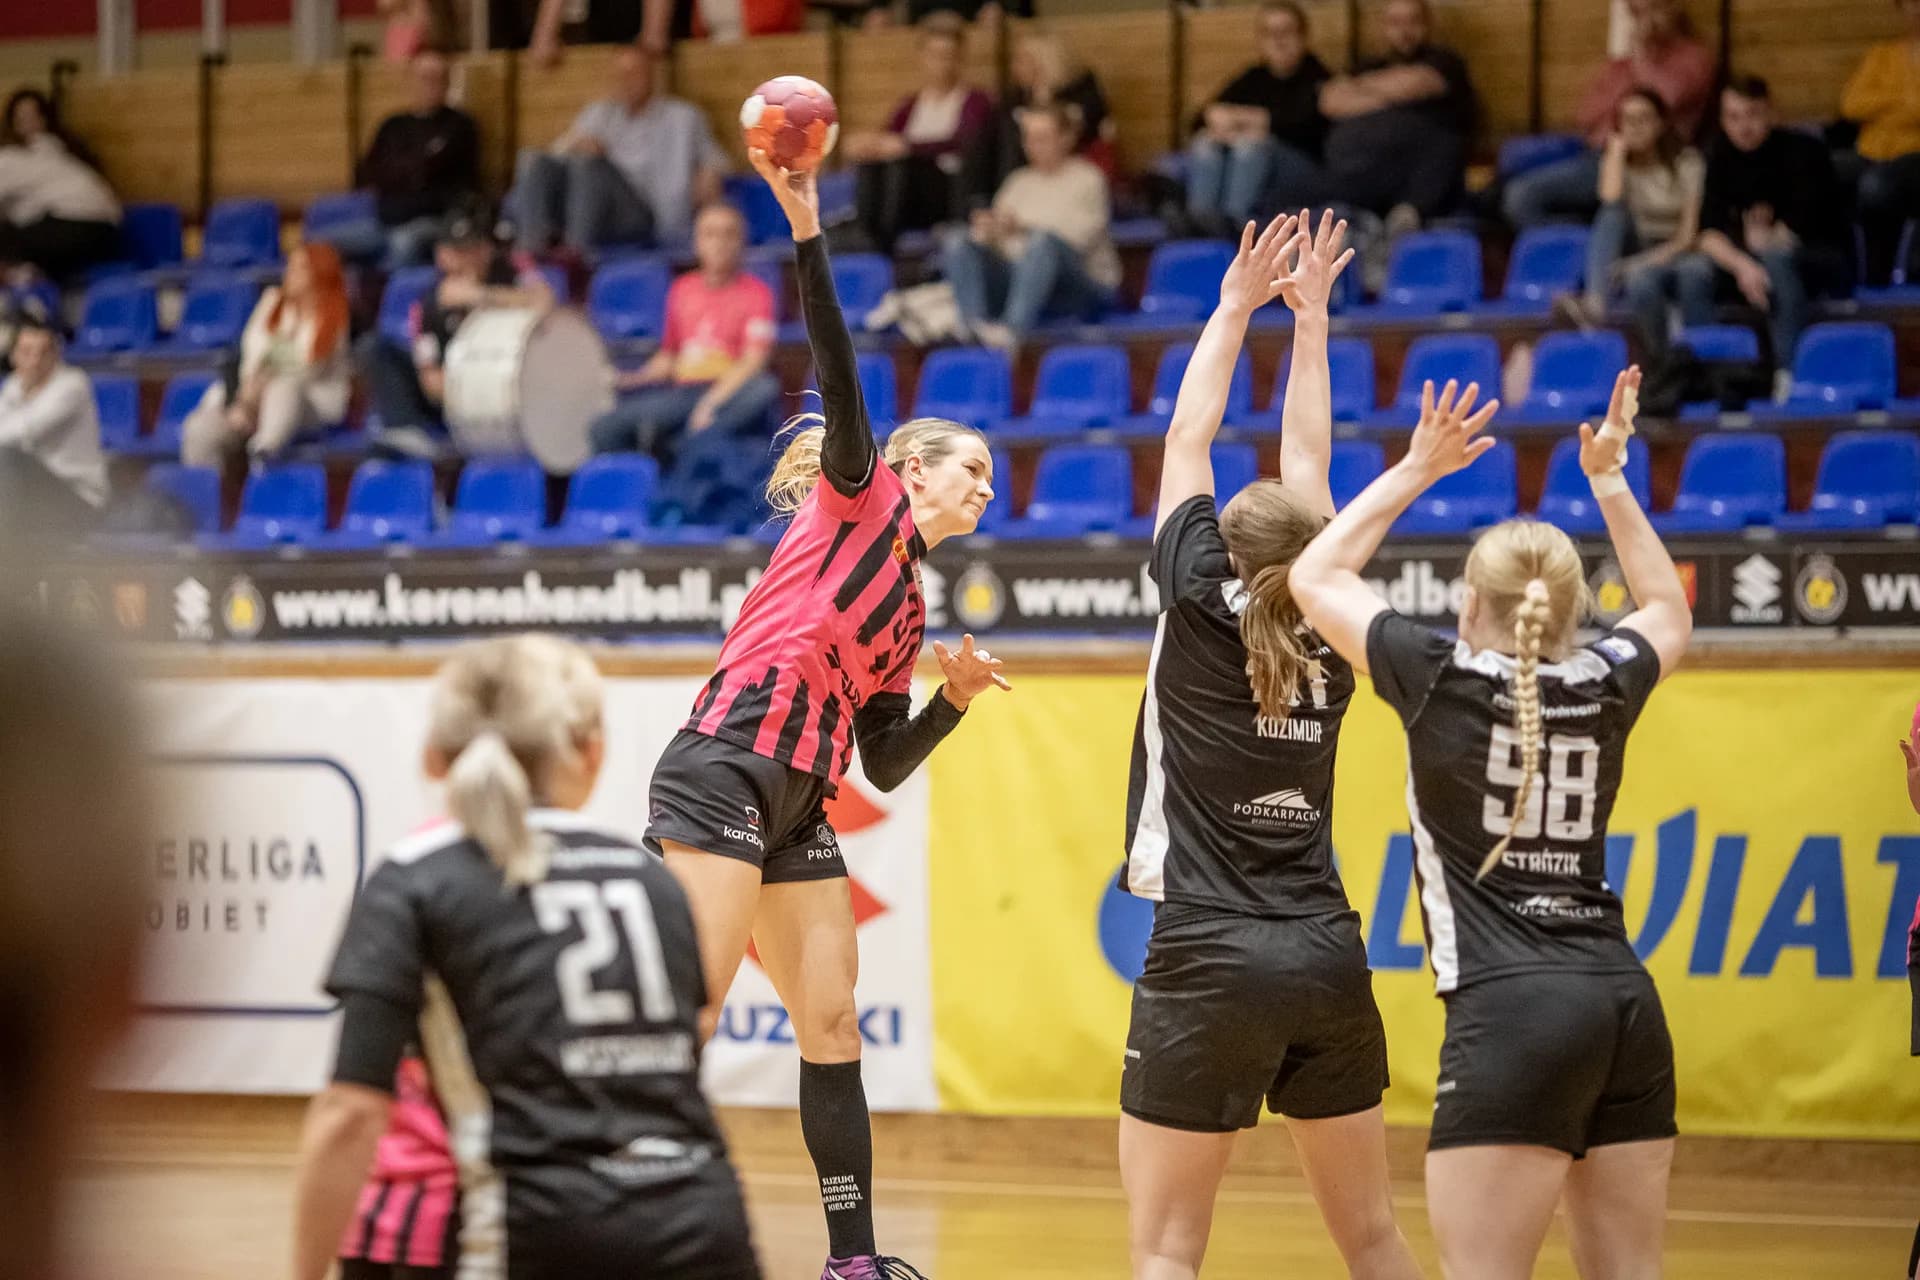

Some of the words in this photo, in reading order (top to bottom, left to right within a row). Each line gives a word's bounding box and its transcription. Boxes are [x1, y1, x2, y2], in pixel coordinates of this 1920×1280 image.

[156, 837, 324, 882] ERLIGA
[147, 903, 270, 931] OBIET
[531, 878, 677, 1025] 21
[715, 1005, 902, 1044] UZKI
[822, 1174, 855, 1186] SUZUKI
[822, 1183, 860, 1195] KORONA
[827, 1200, 857, 1212] KIELCE
